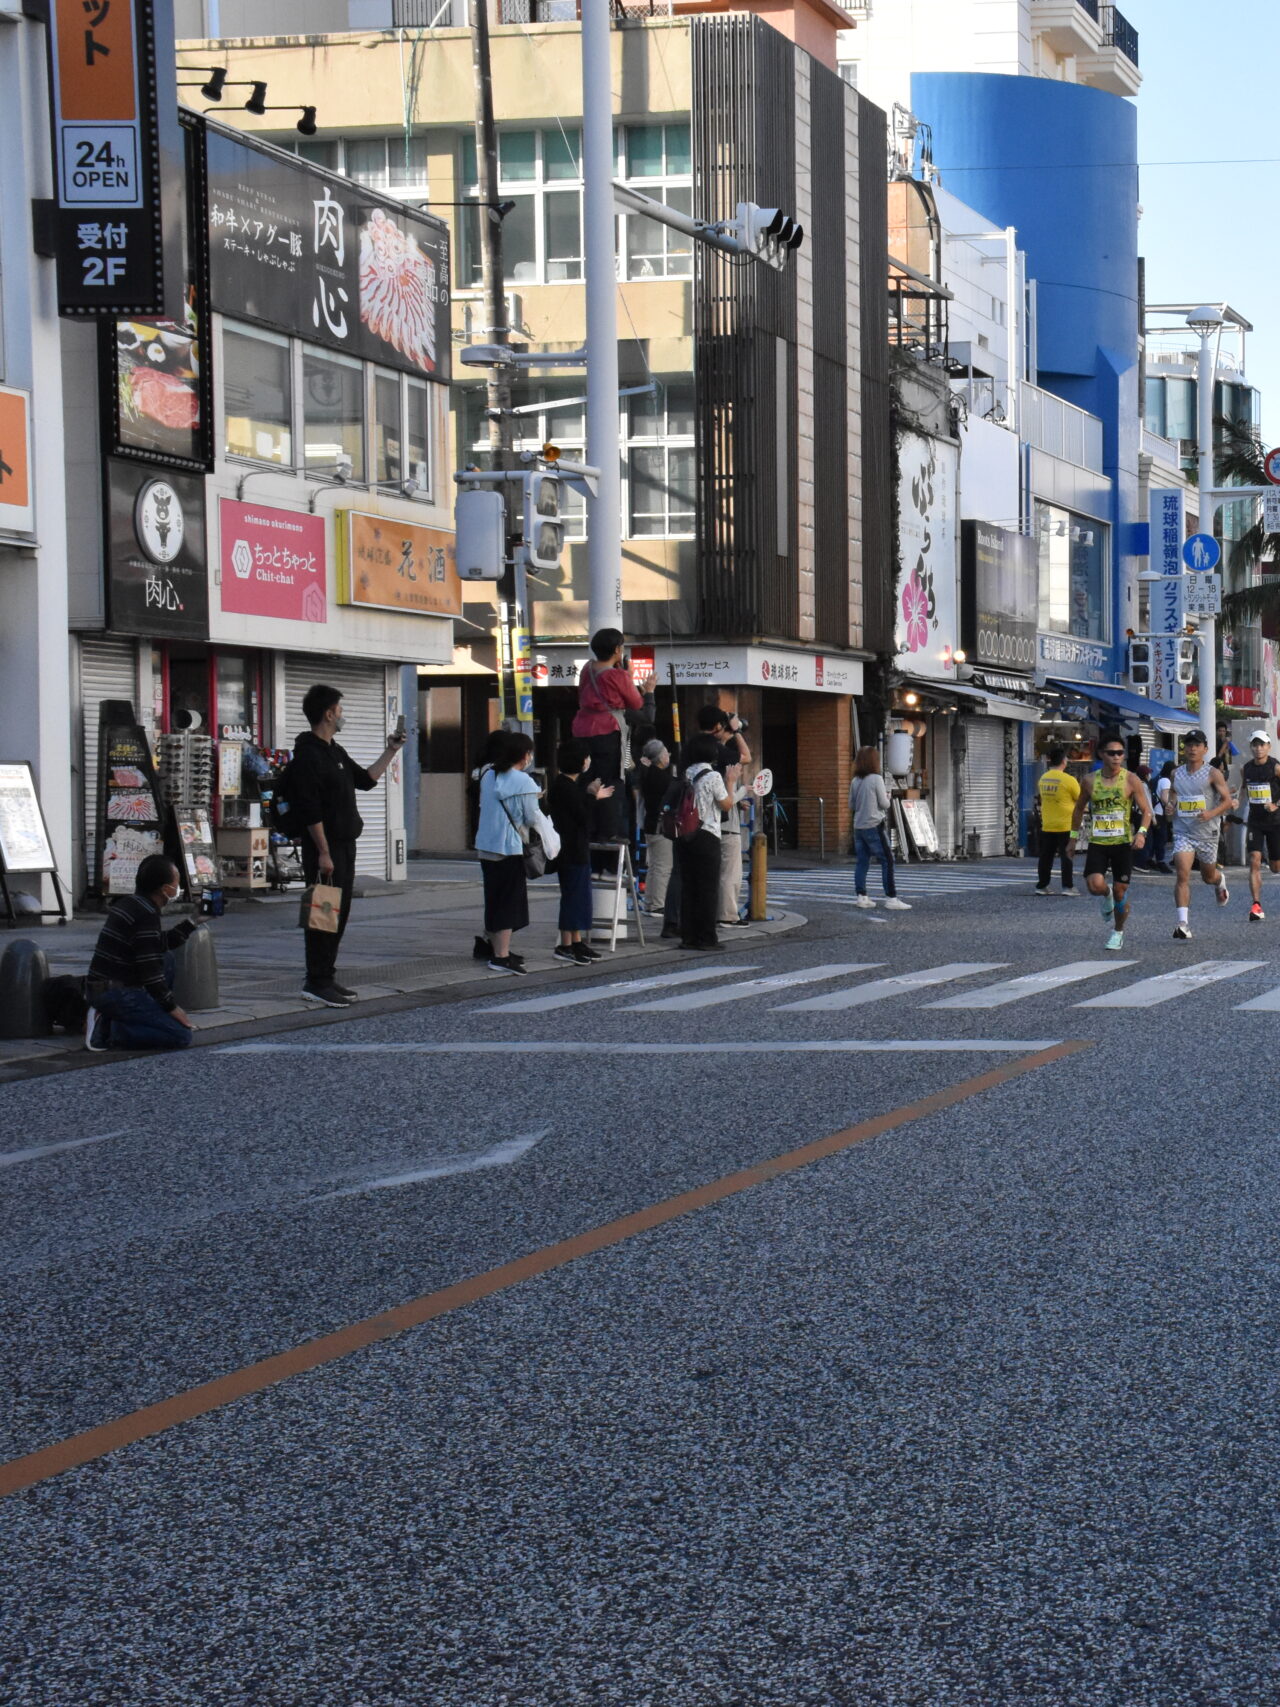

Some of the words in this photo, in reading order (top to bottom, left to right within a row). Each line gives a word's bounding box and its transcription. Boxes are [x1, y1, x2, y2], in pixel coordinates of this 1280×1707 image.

[76, 141, 125, 168] 24h
[73, 172, 129, 187] OPEN
[77, 223, 129, 250] 受付
[82, 256, 127, 286] 2F
[312, 186, 349, 339] 肉心
[254, 543, 317, 573] ちっとちゃっと
[256, 568, 295, 585] Chit-chat
[145, 575, 180, 611] 肉心
